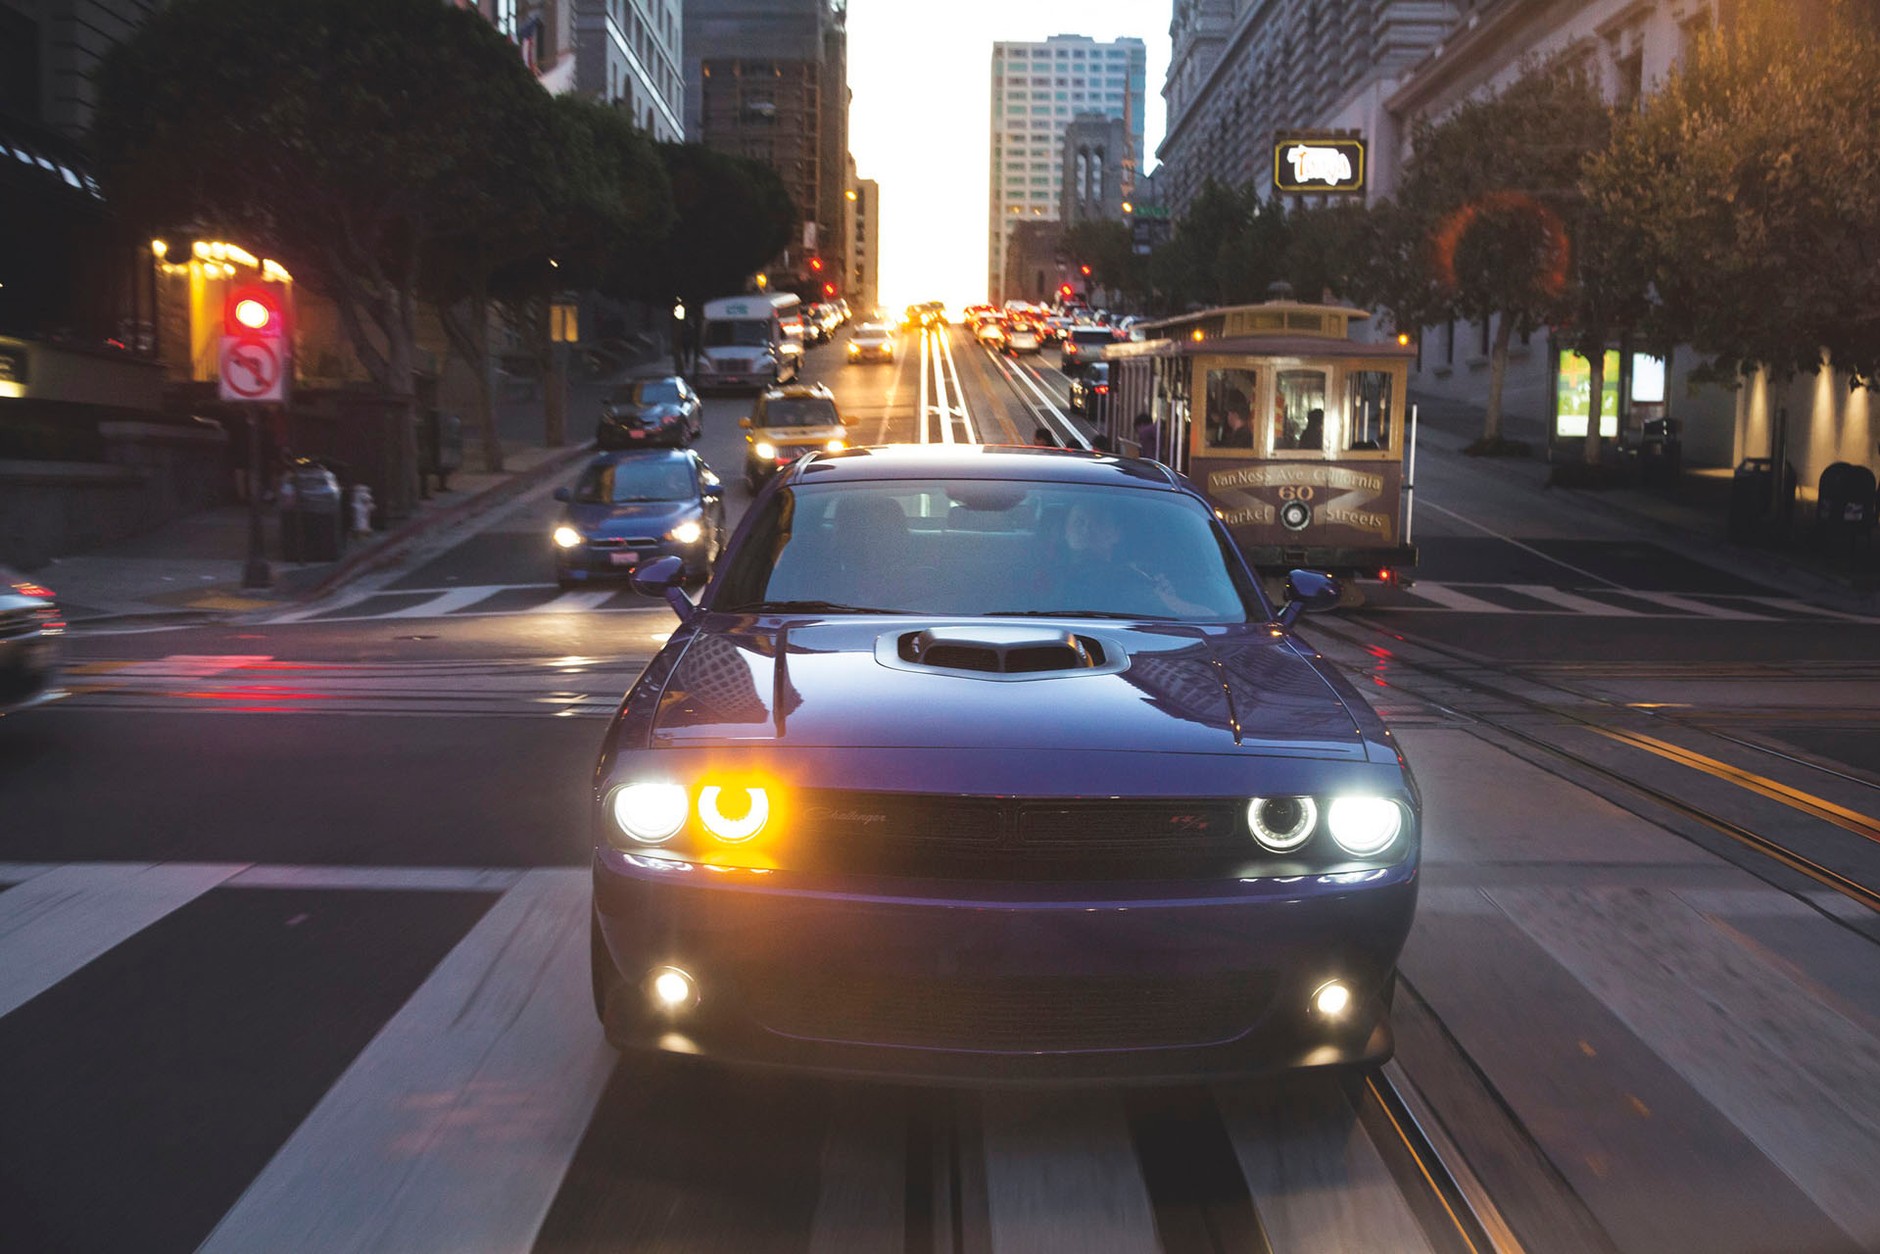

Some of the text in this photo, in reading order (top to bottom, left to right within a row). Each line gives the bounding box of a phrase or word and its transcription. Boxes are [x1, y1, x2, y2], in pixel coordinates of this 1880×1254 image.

[1211, 474, 1237, 487] Van
[1238, 469, 1272, 483] Ness
[1279, 486, 1314, 500] 60
[1326, 508, 1382, 527] Streets
